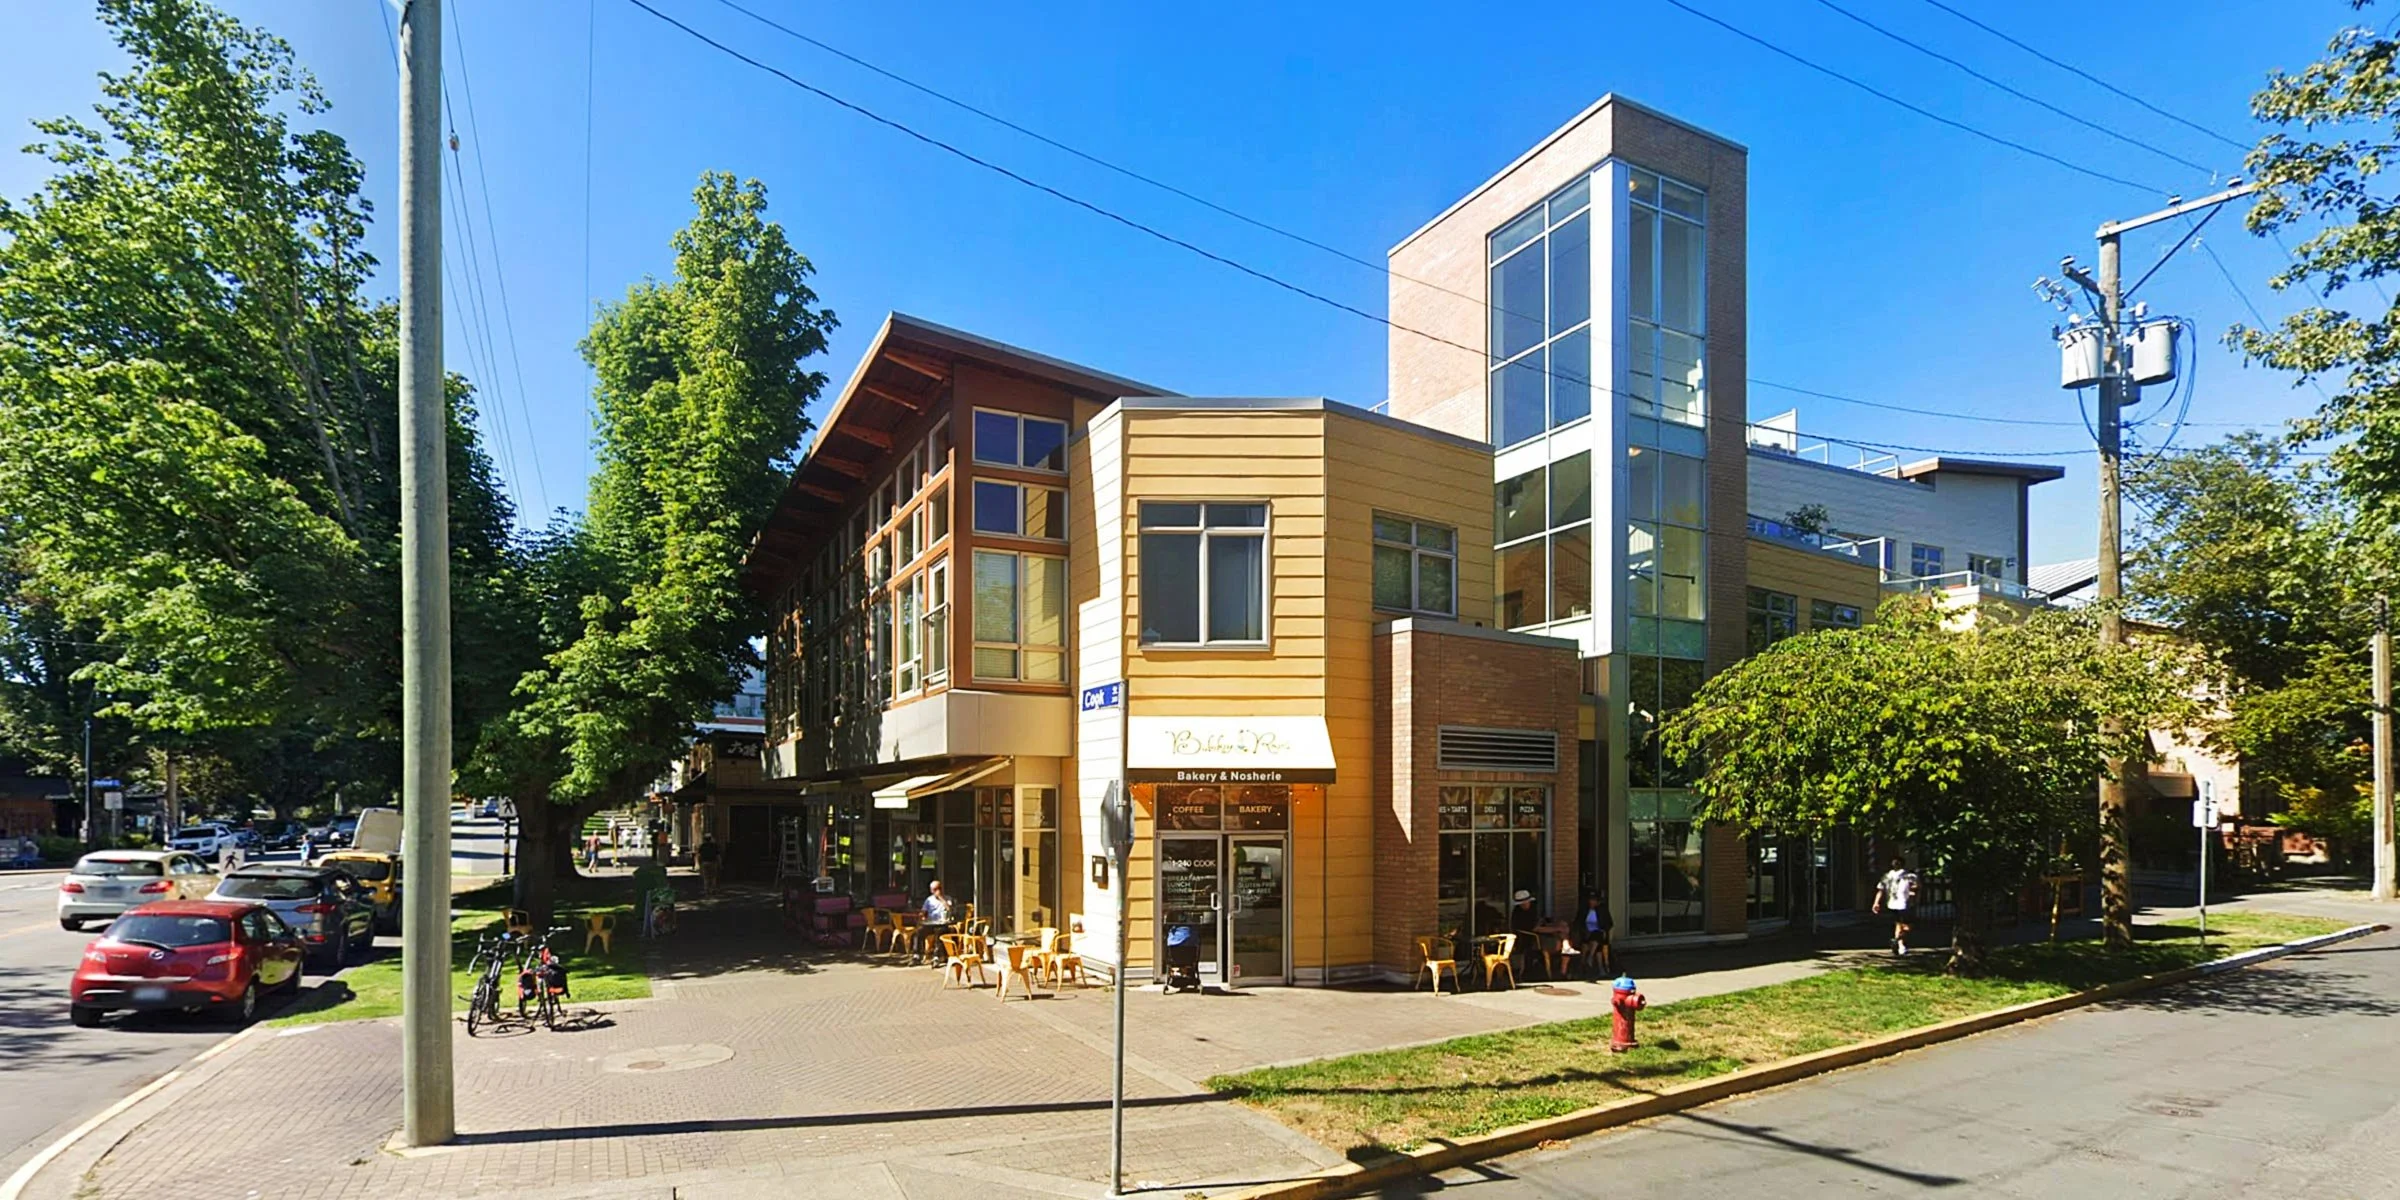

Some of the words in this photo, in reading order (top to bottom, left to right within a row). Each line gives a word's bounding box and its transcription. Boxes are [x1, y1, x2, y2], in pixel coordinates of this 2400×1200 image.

[1085, 689, 1105, 709] Cook
[1177, 771, 1217, 783] Bakery
[1220, 771, 1228, 781] &
[1230, 771, 1282, 781] Nosherie
[1172, 806, 1205, 814] COFFEE
[1239, 805, 1273, 814] BAKERY
[1193, 859, 1217, 868] COOK
